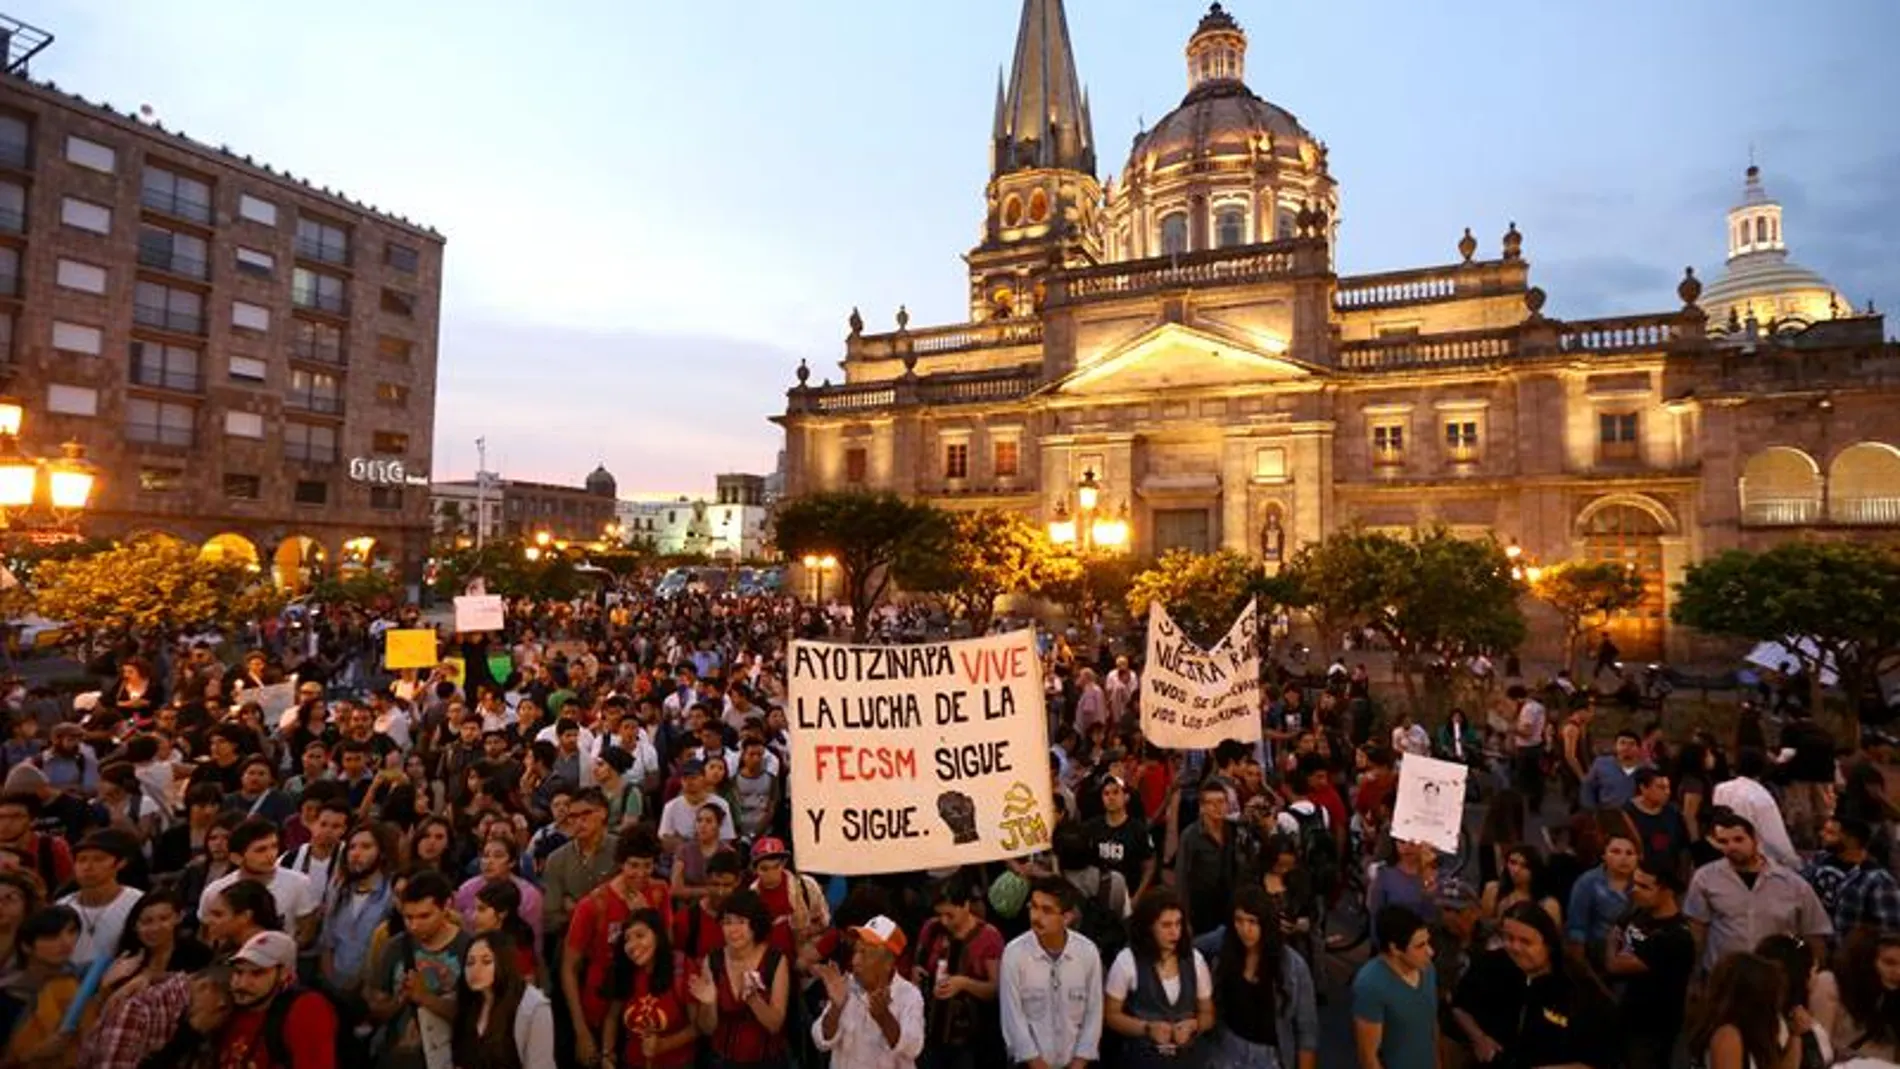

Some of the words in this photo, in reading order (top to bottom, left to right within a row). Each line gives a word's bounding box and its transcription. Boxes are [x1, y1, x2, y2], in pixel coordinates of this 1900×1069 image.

[794, 646, 955, 681] AYOTZINAPA
[960, 646, 1029, 684] VIVE
[797, 697, 836, 729] LA
[842, 694, 922, 729] LUCHA
[935, 691, 969, 725] DE
[984, 686, 1015, 720] LA
[815, 745, 918, 782] FECSM
[935, 741, 1012, 781] SIGUE
[807, 809, 825, 843] Y
[842, 807, 930, 842] SIGUE.
